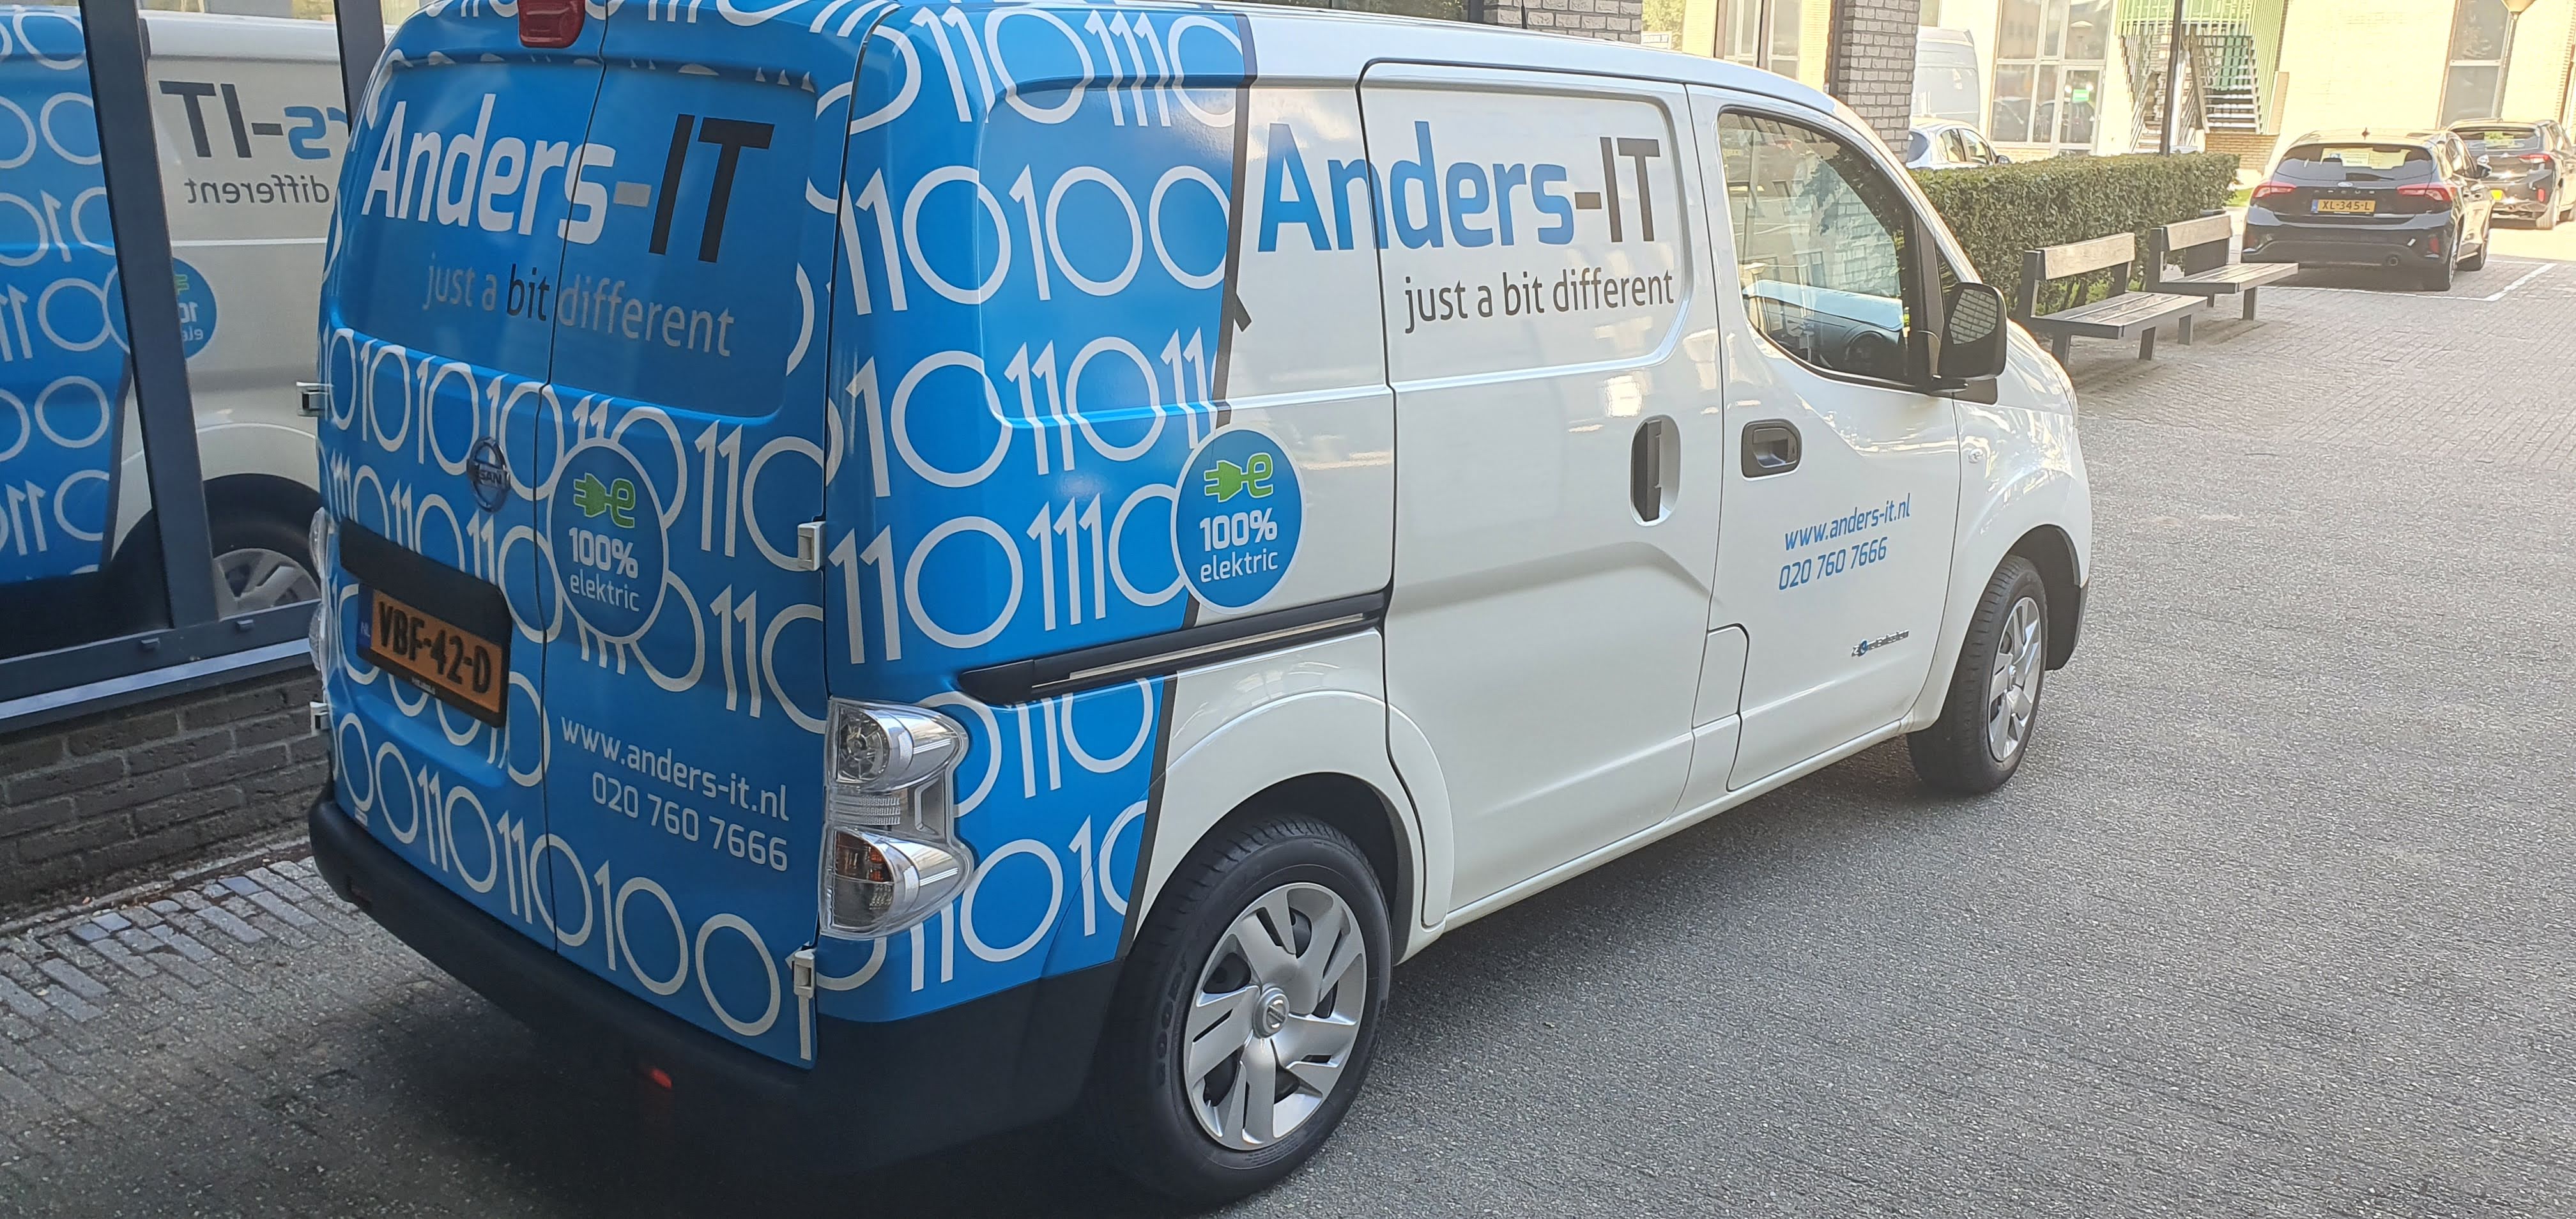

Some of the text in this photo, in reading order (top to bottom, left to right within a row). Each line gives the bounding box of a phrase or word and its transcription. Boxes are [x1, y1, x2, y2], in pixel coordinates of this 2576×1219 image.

[361, 93, 775, 263] Anders-IT
[1257, 121, 1660, 252] Anders-IT
[2322, 200, 2371, 211] XL-345-L
[422, 253, 735, 358] just a bit different
[1405, 267, 1674, 334] just a bit different
[569, 527, 638, 579] 100%
[1200, 507, 1278, 552] 100%
[1784, 493, 1911, 551] www.anders-it.nl
[570, 569, 640, 612] elektric
[1200, 548, 1278, 583] elektric
[1779, 536, 1888, 590] 020 760 7666
[378, 601, 491, 694] VBF-42-D
[561, 716, 790, 822] www.anders-it.nl
[592, 771, 788, 873] 020 760 7666
